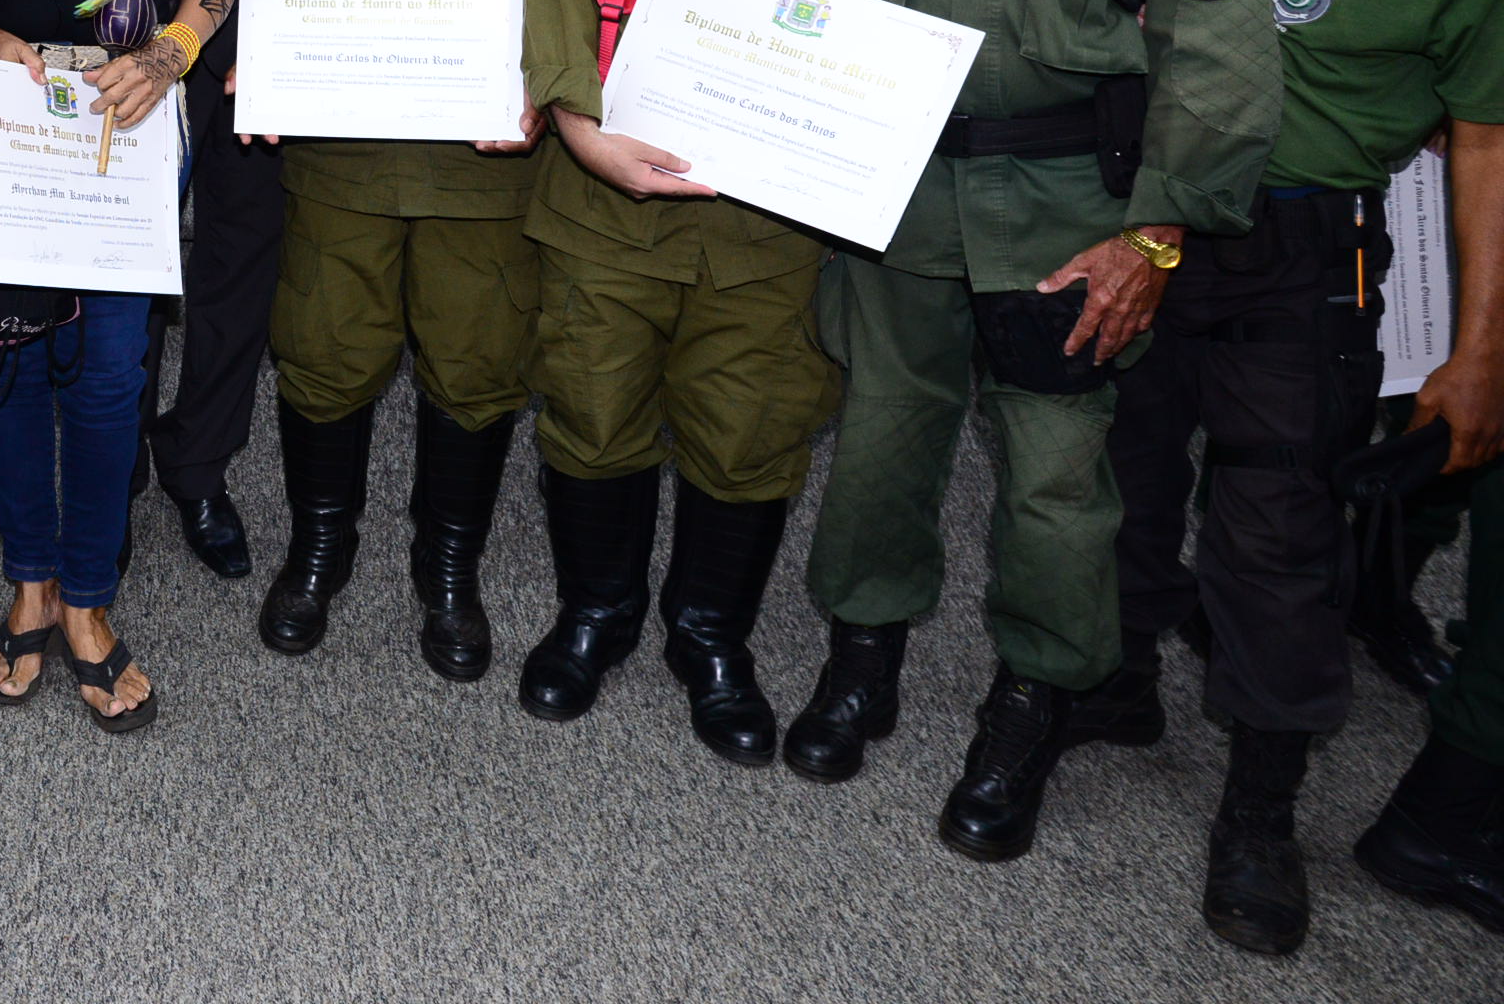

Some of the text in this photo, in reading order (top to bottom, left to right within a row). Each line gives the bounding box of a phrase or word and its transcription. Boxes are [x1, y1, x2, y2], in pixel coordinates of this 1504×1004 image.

[407, 0, 422, 9] ao
[294, 51, 464, 66] Antonio Carlos de Oliveira Roque
[684, 10, 897, 90] Diploma de Honra ao Mérito
[696, 36, 866, 101] Câmara Municipal de Goiânia
[692, 81, 736, 104] Antonio
[739, 98, 776, 118] Carlos
[779, 111, 798, 125] dos
[38, 124, 48, 137] de
[52, 125, 81, 143] Honra
[85, 134, 97, 144] ao
[104, 133, 137, 147] érito
[10, 139, 40, 153] Câmara
[43, 144, 79, 158] Municipal
[81, 150, 90, 160] de
[104, 194, 112, 203] do
[1413, 179, 1424, 212] Fabiana
[1416, 215, 1427, 237] Aires
[1417, 239, 1427, 252] dos
[1418, 254, 1428, 284] Santos
[1420, 286, 1431, 319] Oliveira
[1423, 322, 1433, 355] Teixeira
